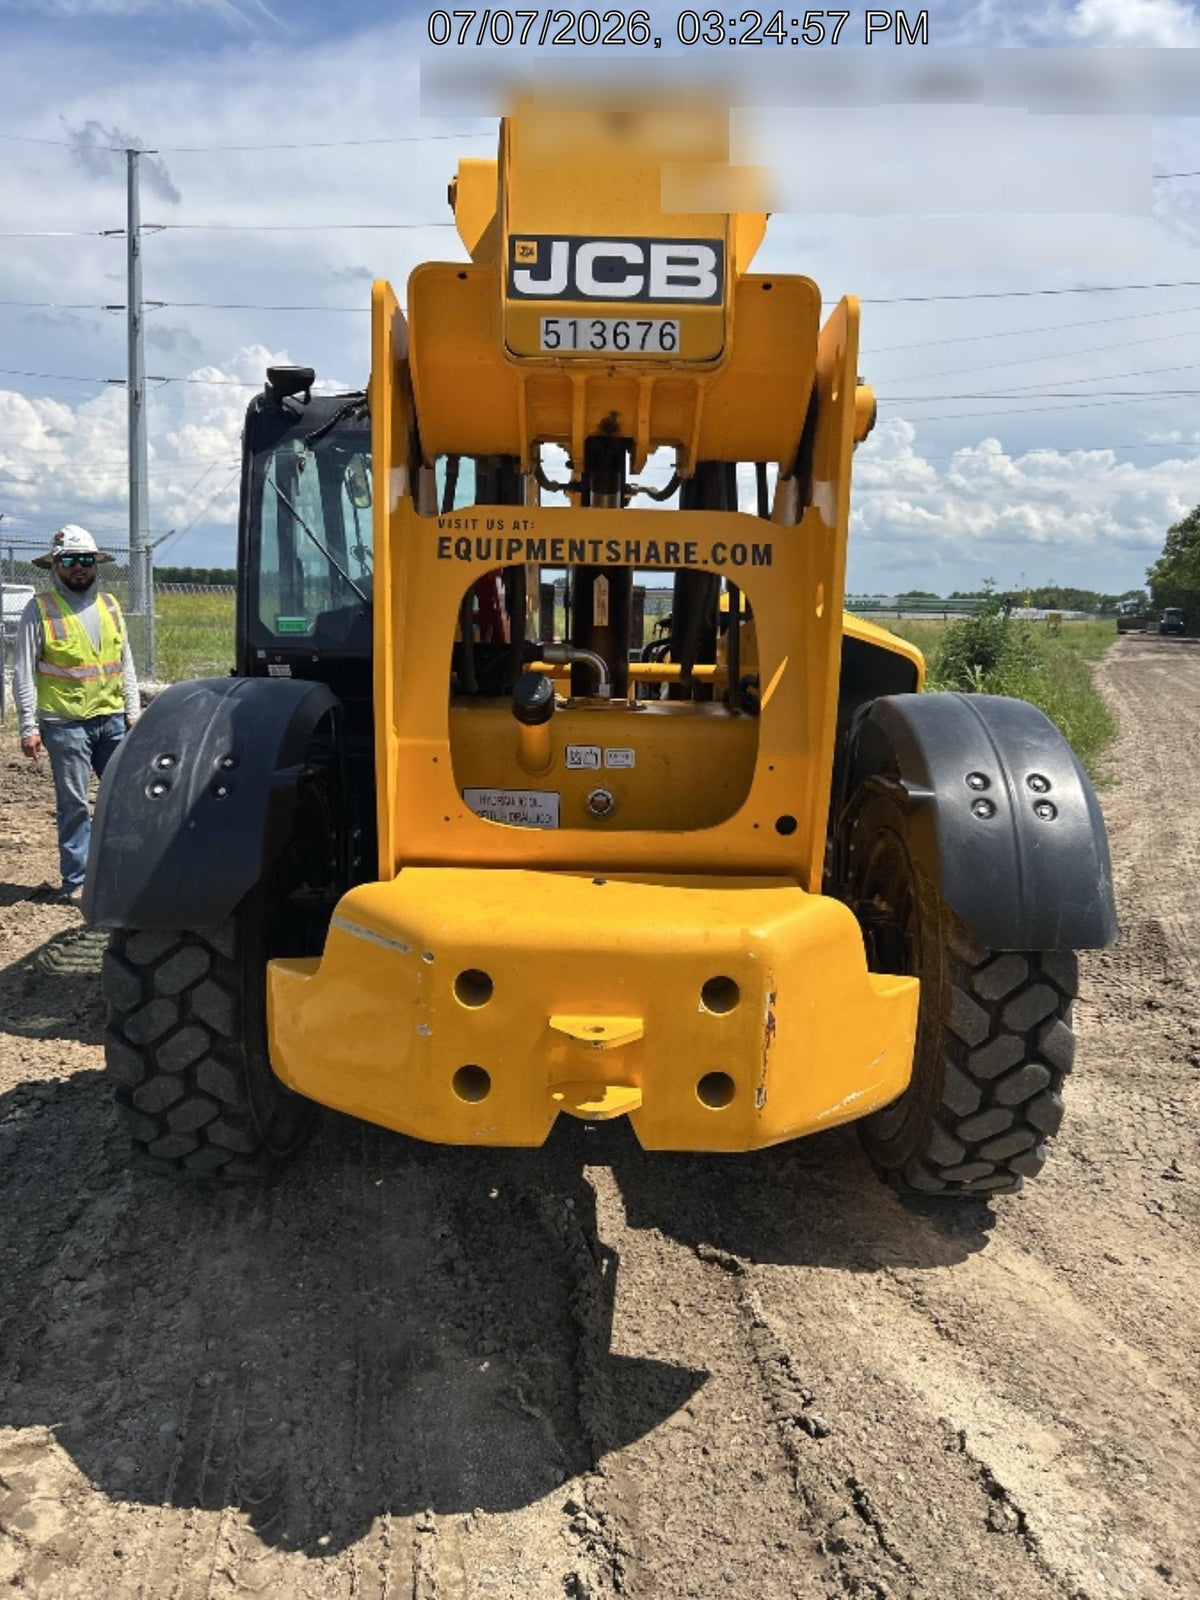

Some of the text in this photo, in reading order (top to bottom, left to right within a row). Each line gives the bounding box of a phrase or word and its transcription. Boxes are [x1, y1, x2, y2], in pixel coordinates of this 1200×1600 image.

[513, 241, 718, 299] JCB
[543, 319, 677, 351] 513676
[438, 518, 534, 531] VISIT US AT:
[437, 536, 772, 567] EQUIPMENTSHARE.COM
